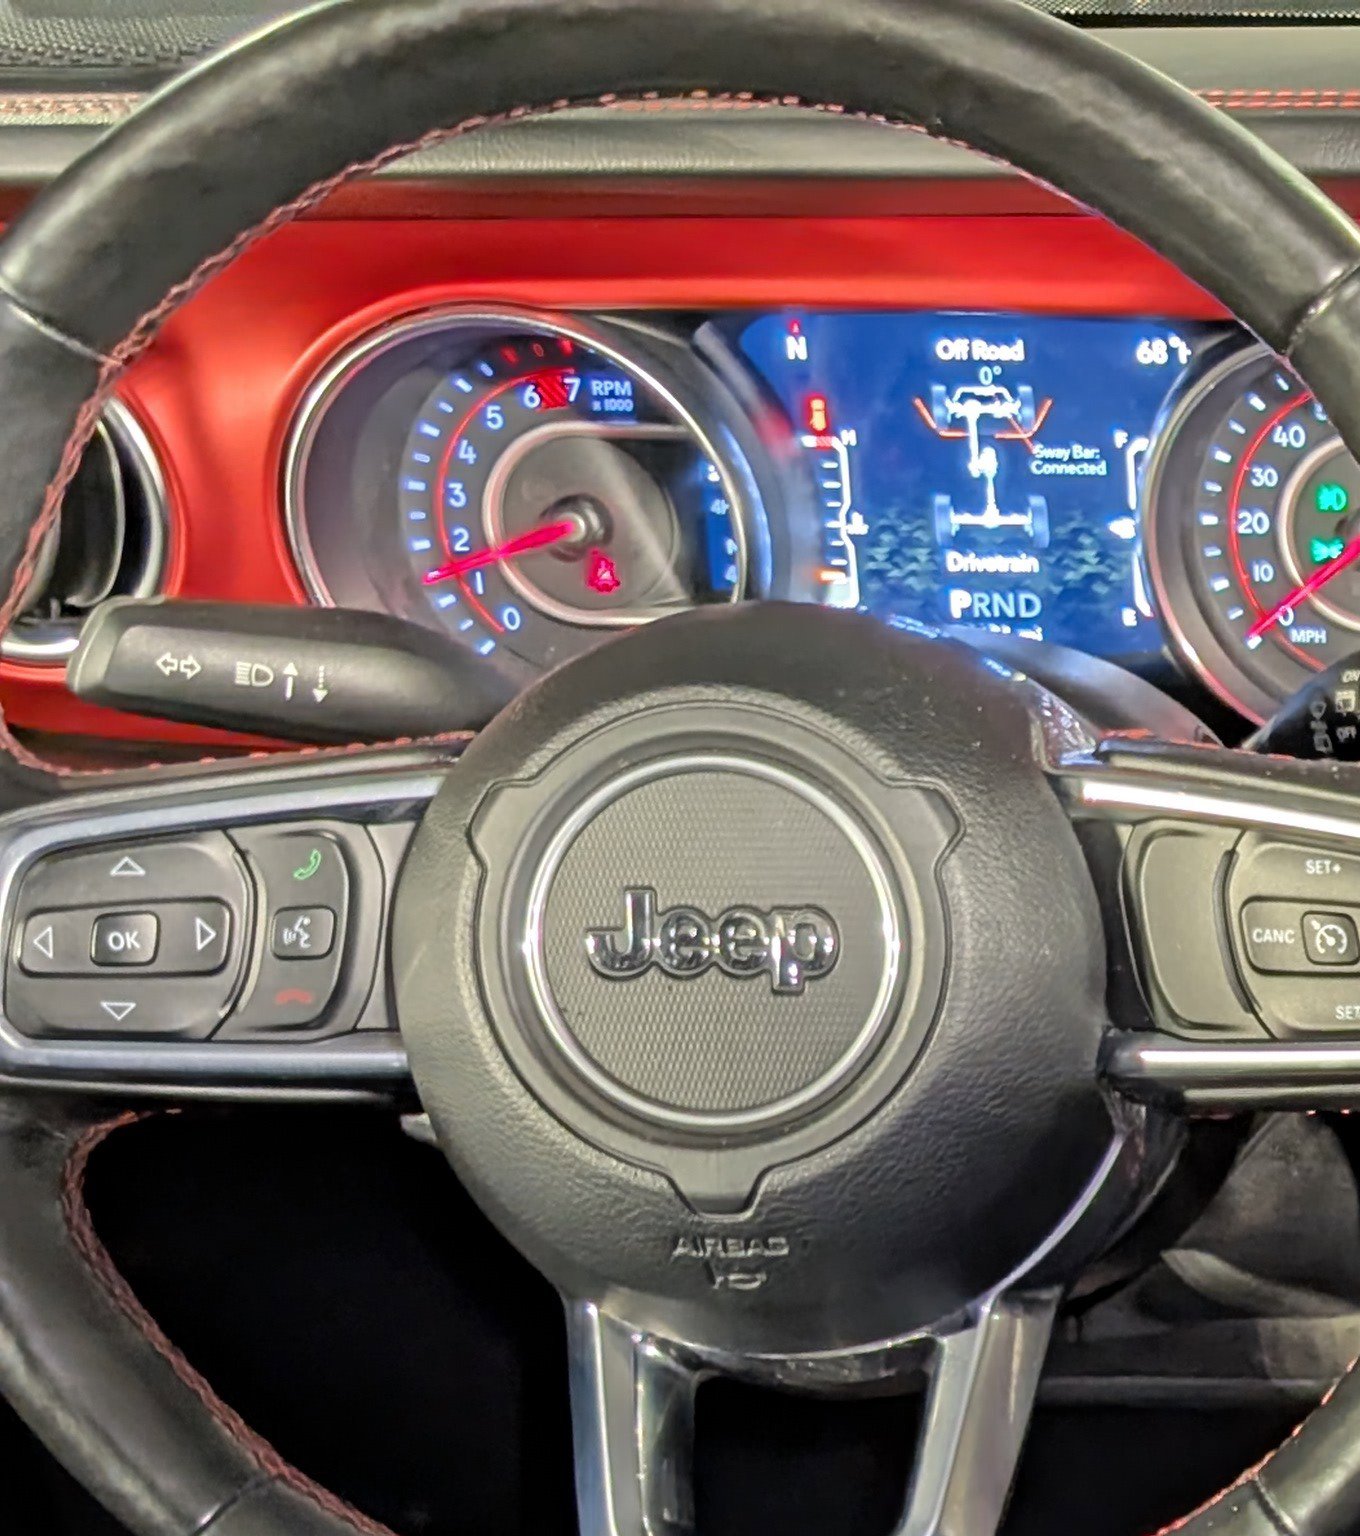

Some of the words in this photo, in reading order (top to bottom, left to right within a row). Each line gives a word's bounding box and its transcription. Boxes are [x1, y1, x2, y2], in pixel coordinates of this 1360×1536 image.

[786, 336, 808, 361] N
[936, 339, 969, 362] Off
[972, 339, 1025, 362] Road
[523, 384, 541, 409] 6
[566, 377, 581, 402] 7
[591, 380, 632, 397] RPM
[485, 405, 504, 430] 5
[1272, 425, 1306, 449] 40
[458, 439, 477, 464] 4
[1033, 444, 1072, 462] Sway
[1031, 459, 1107, 476] Connected
[1250, 467, 1278, 488] 30
[448, 483, 467, 508] 3
[1237, 511, 1270, 535] 20
[453, 528, 470, 553] 2
[946, 552, 1040, 574] Drivetrain
[1251, 564, 1275, 583] 10
[474, 571, 484, 595] 1
[502, 606, 521, 631] 0
[1290, 628, 1327, 645] MPH
[1305, 859, 1342, 875] SET+
[107, 930, 141, 950] OK
[585, 886, 840, 996] Jeep
[1252, 928, 1295, 945] CANC
